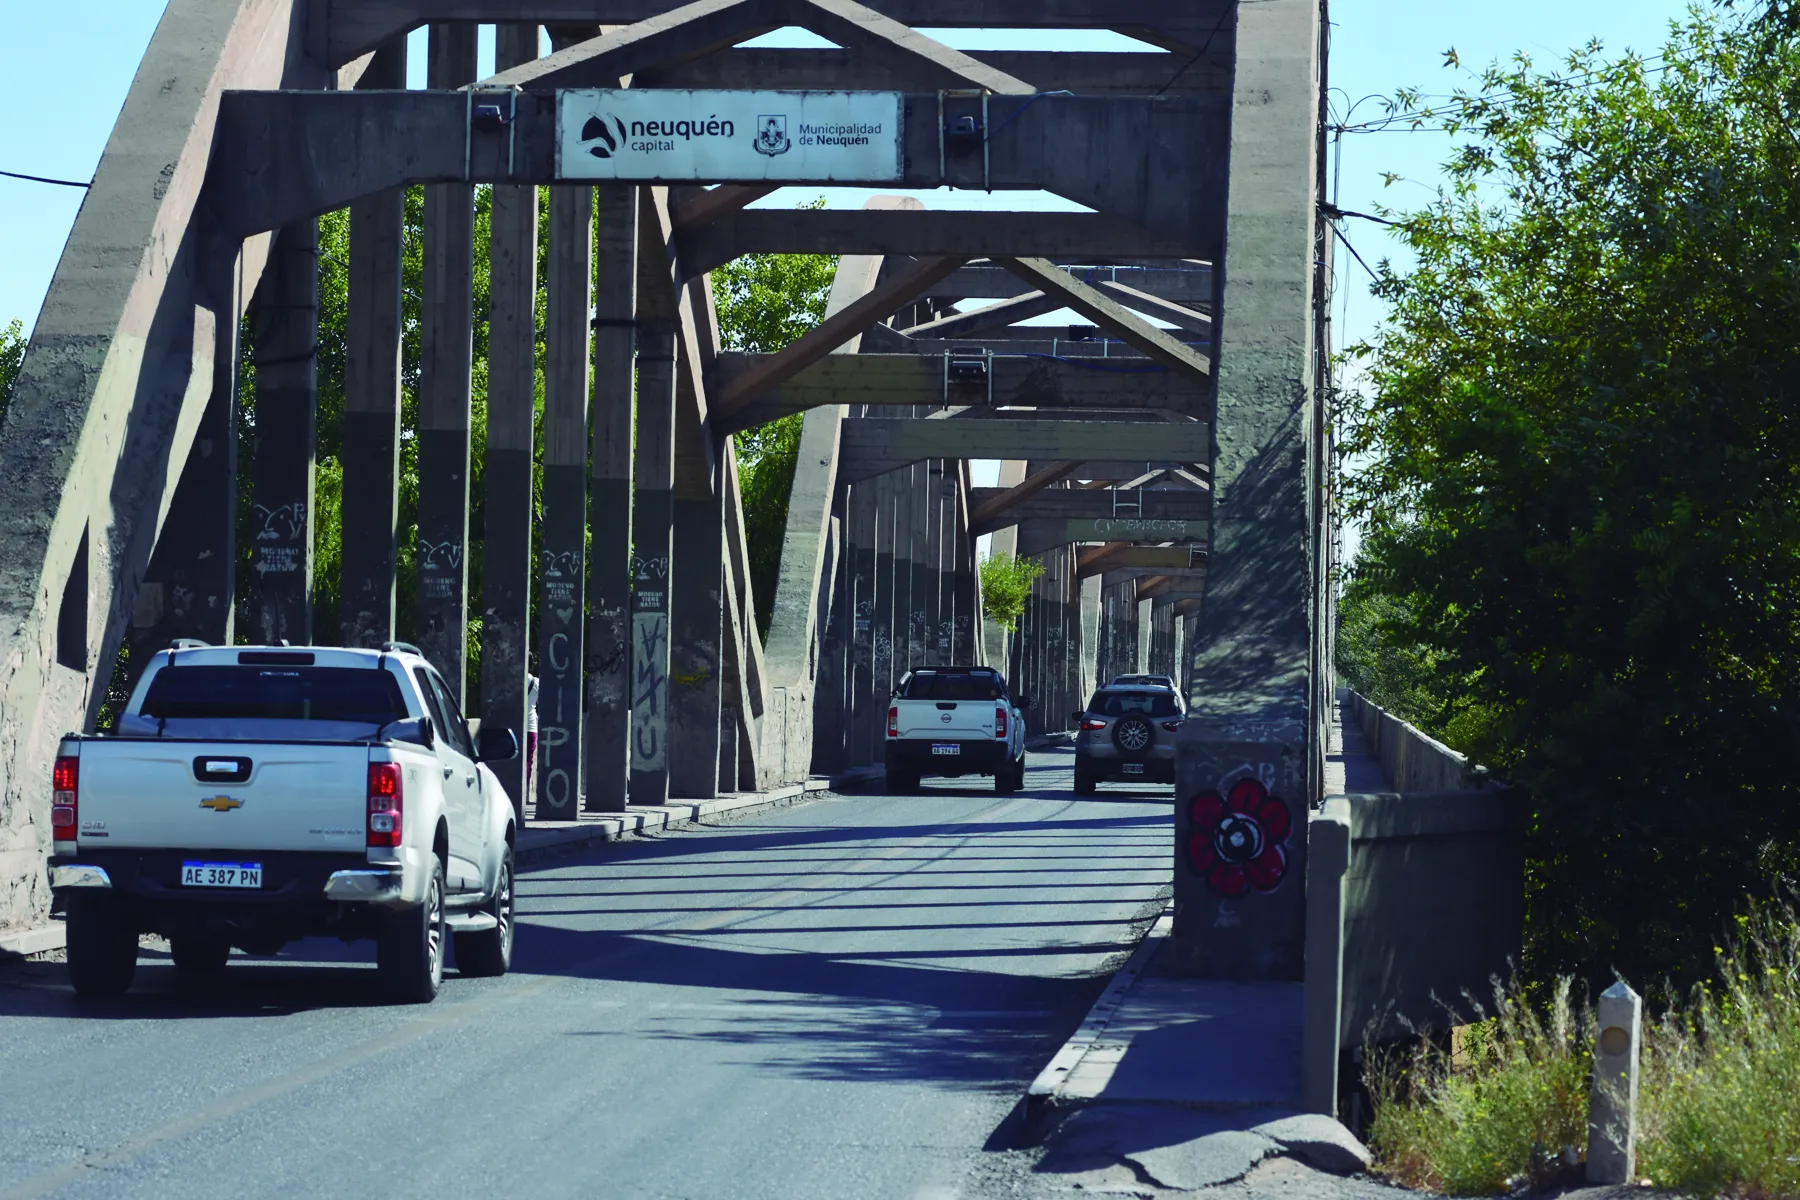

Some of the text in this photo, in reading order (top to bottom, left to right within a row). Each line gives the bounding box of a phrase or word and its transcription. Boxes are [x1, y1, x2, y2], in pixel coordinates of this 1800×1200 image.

[631, 114, 734, 140] neuquén
[799, 123, 882, 136] Municipalidad
[631, 140, 675, 154] capital
[799, 134, 869, 147] de Neuquén
[185, 868, 258, 885] AE 387 PN
